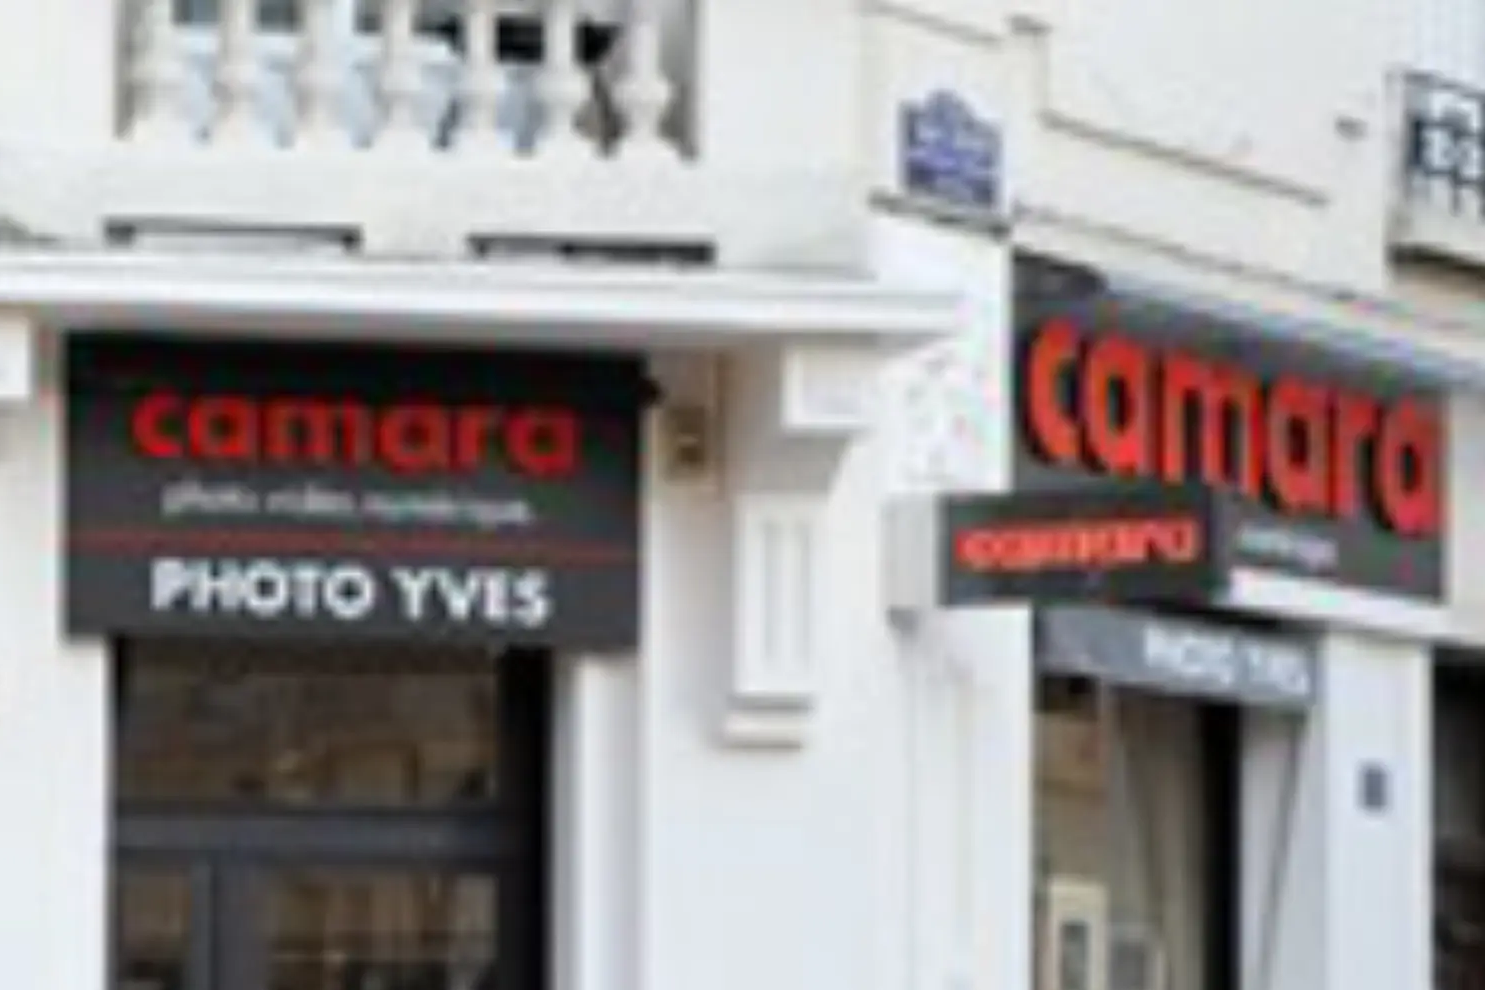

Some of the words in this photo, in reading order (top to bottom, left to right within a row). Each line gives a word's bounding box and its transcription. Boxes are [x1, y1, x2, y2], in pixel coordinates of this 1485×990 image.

[129, 388, 581, 476] camara
[1025, 318, 1445, 536] camara
[955, 517, 1199, 574] camara
[149, 556, 379, 620] PHOTO
[389, 564, 554, 630] YVES
